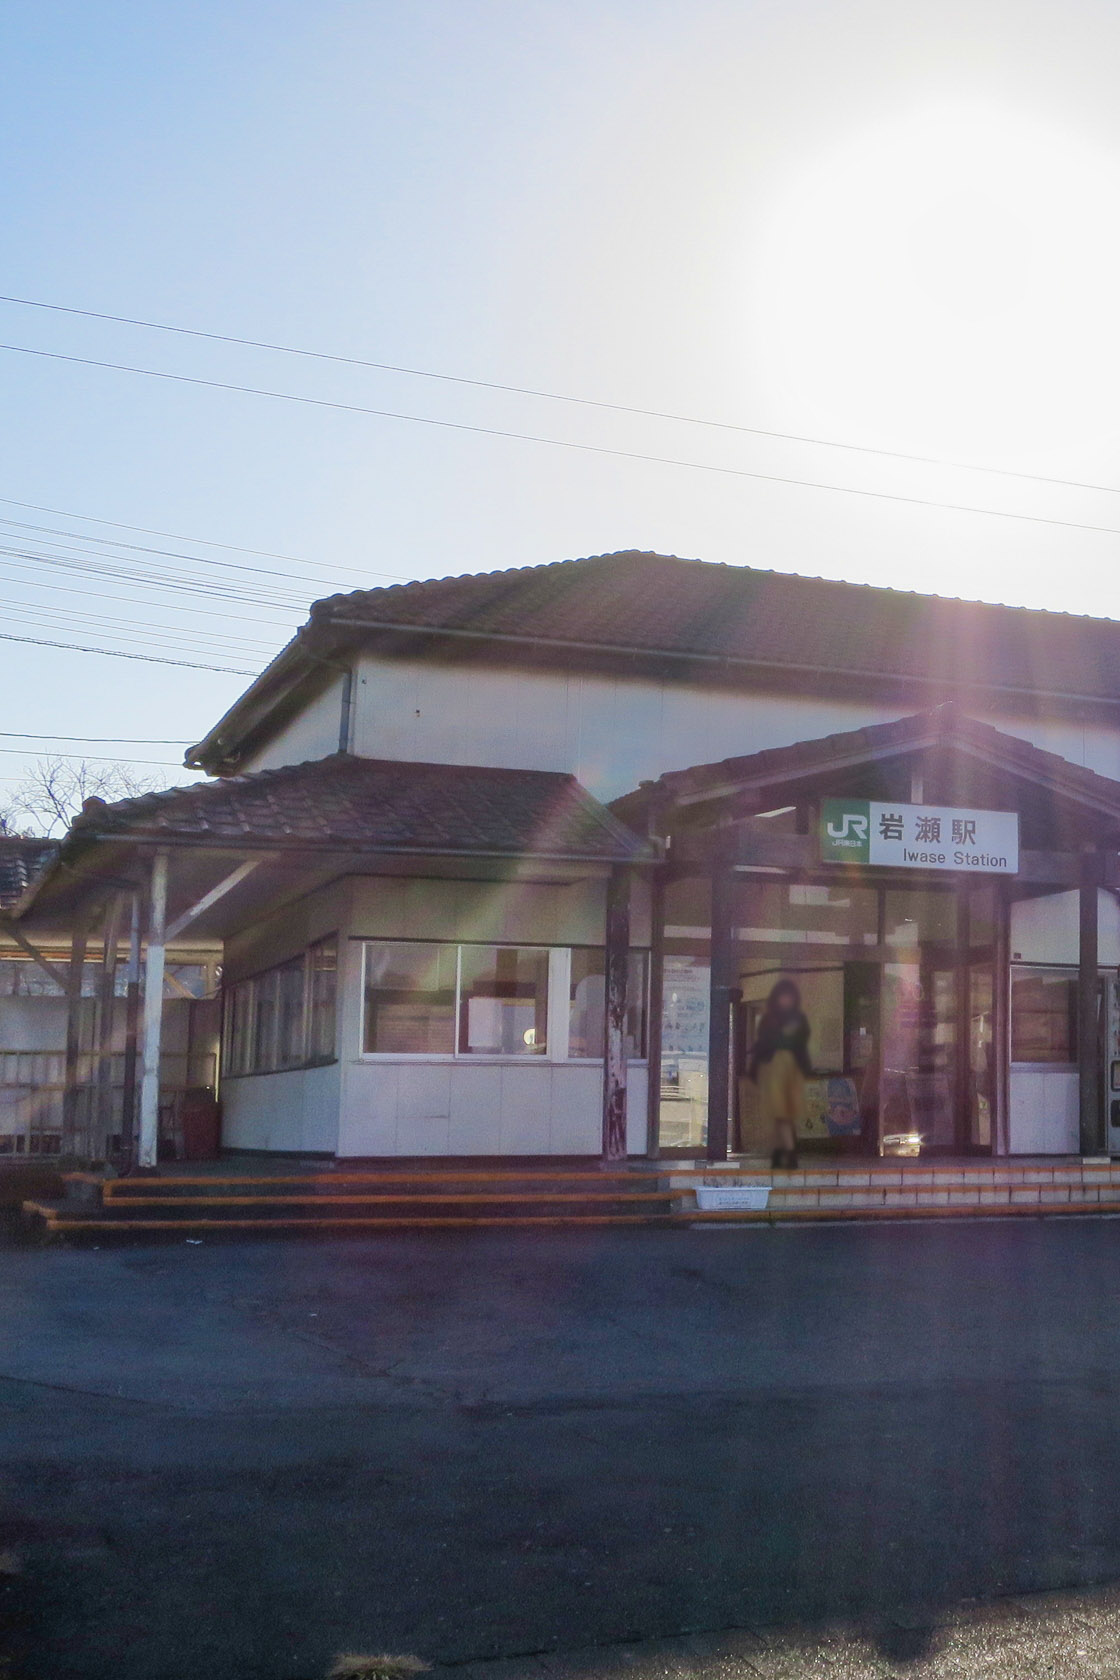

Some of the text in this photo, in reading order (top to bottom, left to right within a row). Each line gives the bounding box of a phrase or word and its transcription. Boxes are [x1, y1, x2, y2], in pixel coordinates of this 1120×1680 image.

[827, 814, 867, 839] JR
[879, 813, 976, 845] 岩瀬駅
[903, 848, 1007, 867] Iwase Station
